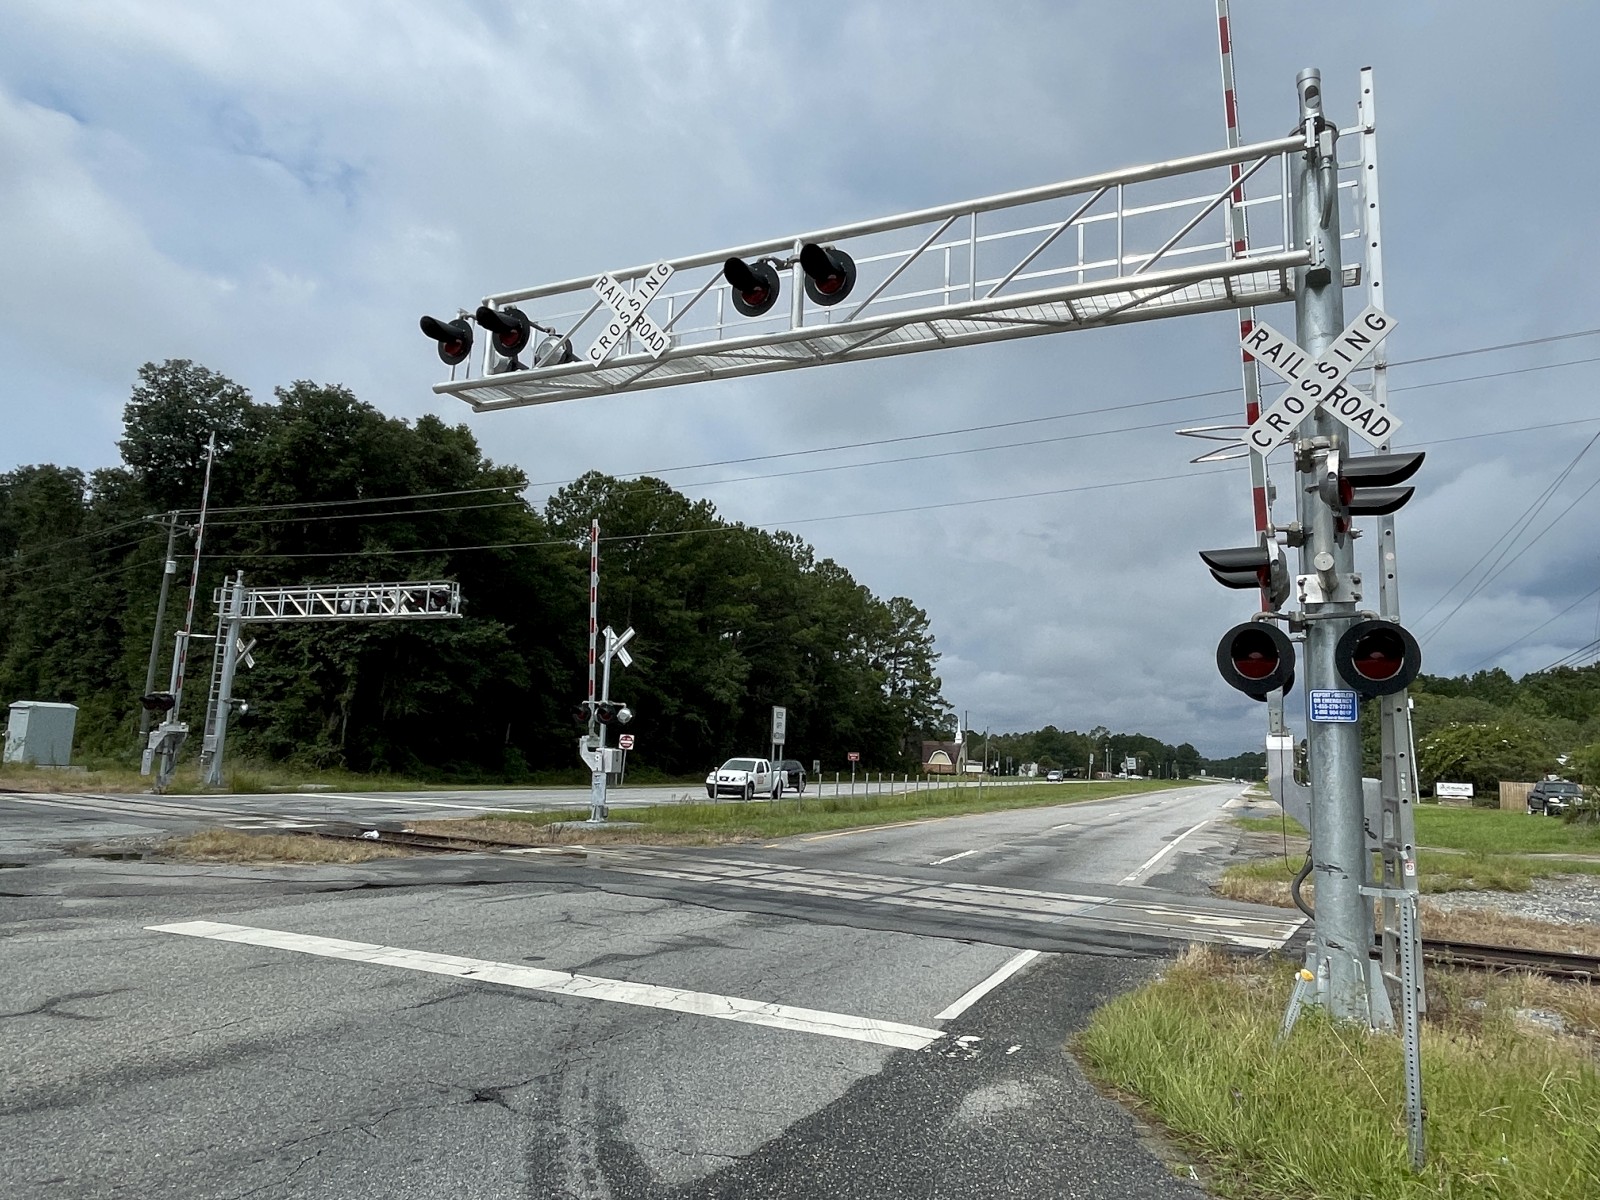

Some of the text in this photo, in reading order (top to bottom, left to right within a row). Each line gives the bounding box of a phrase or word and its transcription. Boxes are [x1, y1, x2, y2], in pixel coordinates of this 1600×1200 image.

[590, 263, 669, 361] CROSSING
[596, 276, 665, 352] RAIL ROAD
[1246, 328, 1391, 437] RAIL ROAD
[1251, 313, 1387, 448] CROSSING
